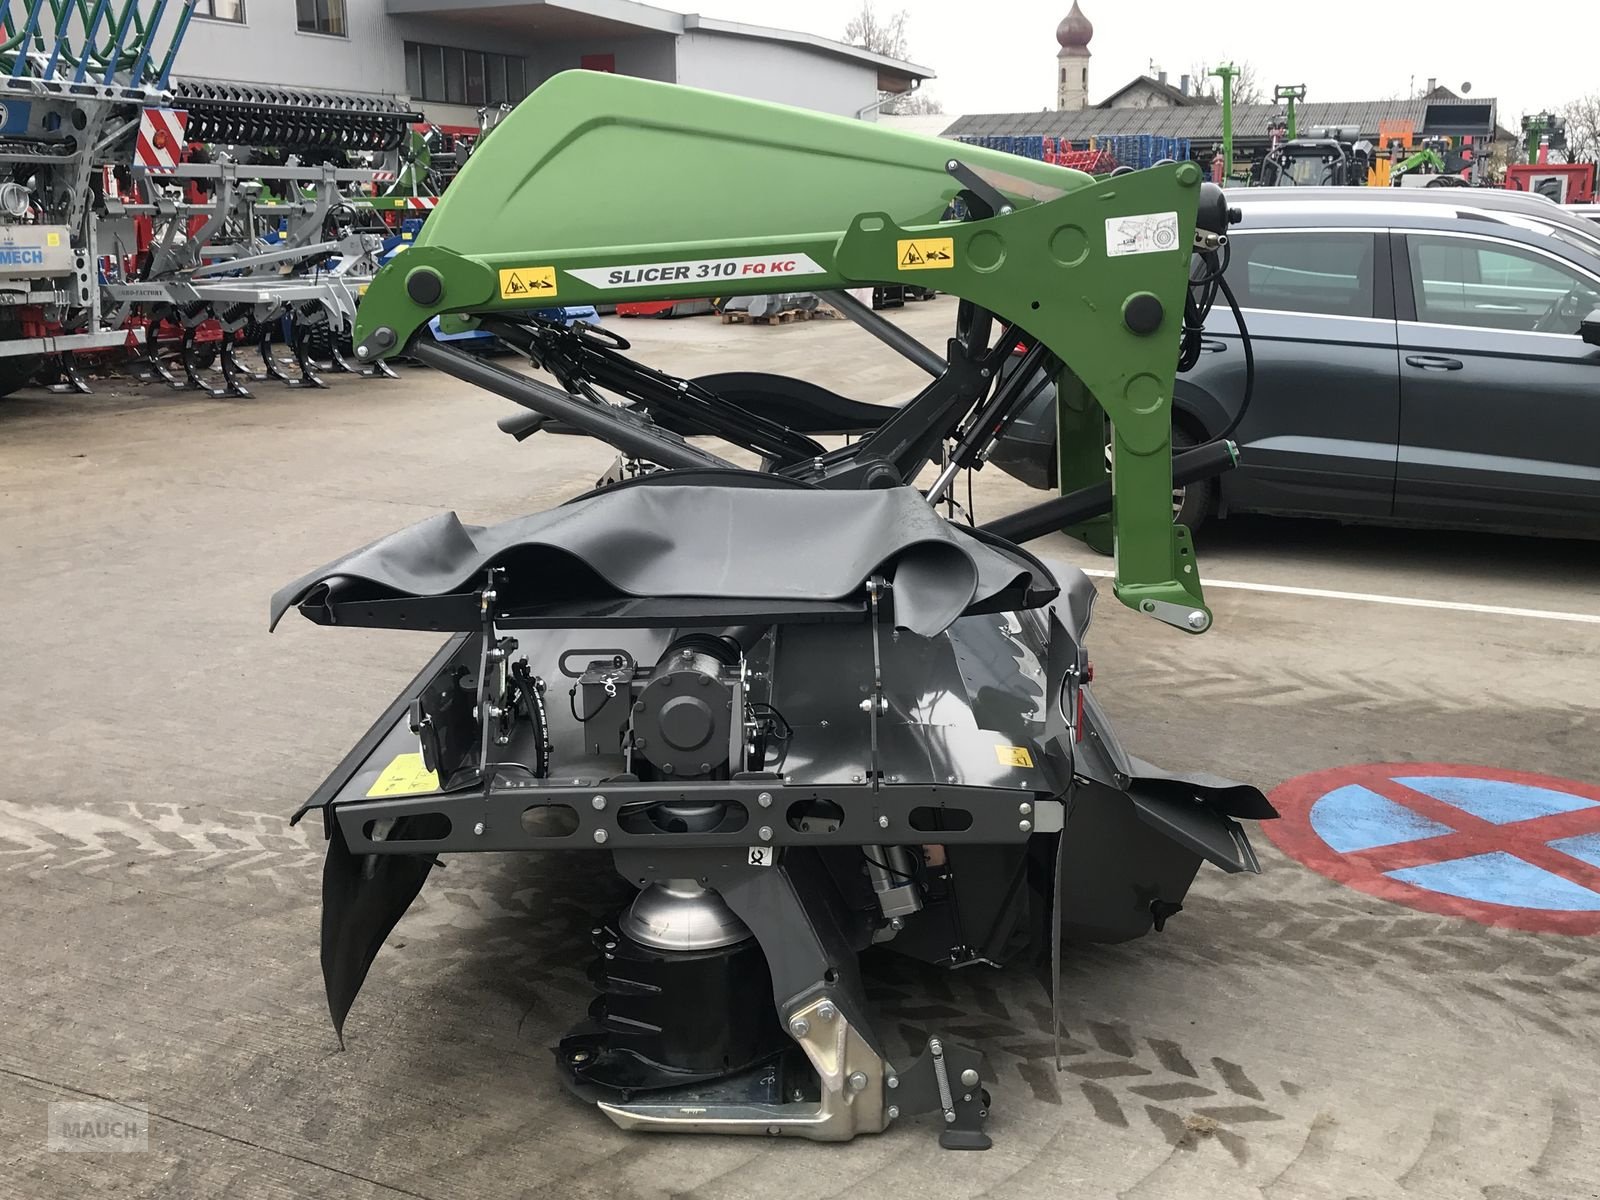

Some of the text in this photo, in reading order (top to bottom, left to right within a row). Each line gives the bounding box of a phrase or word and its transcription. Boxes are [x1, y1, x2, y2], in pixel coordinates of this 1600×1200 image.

[608, 260, 796, 284] SLICER 310 FQ KC
